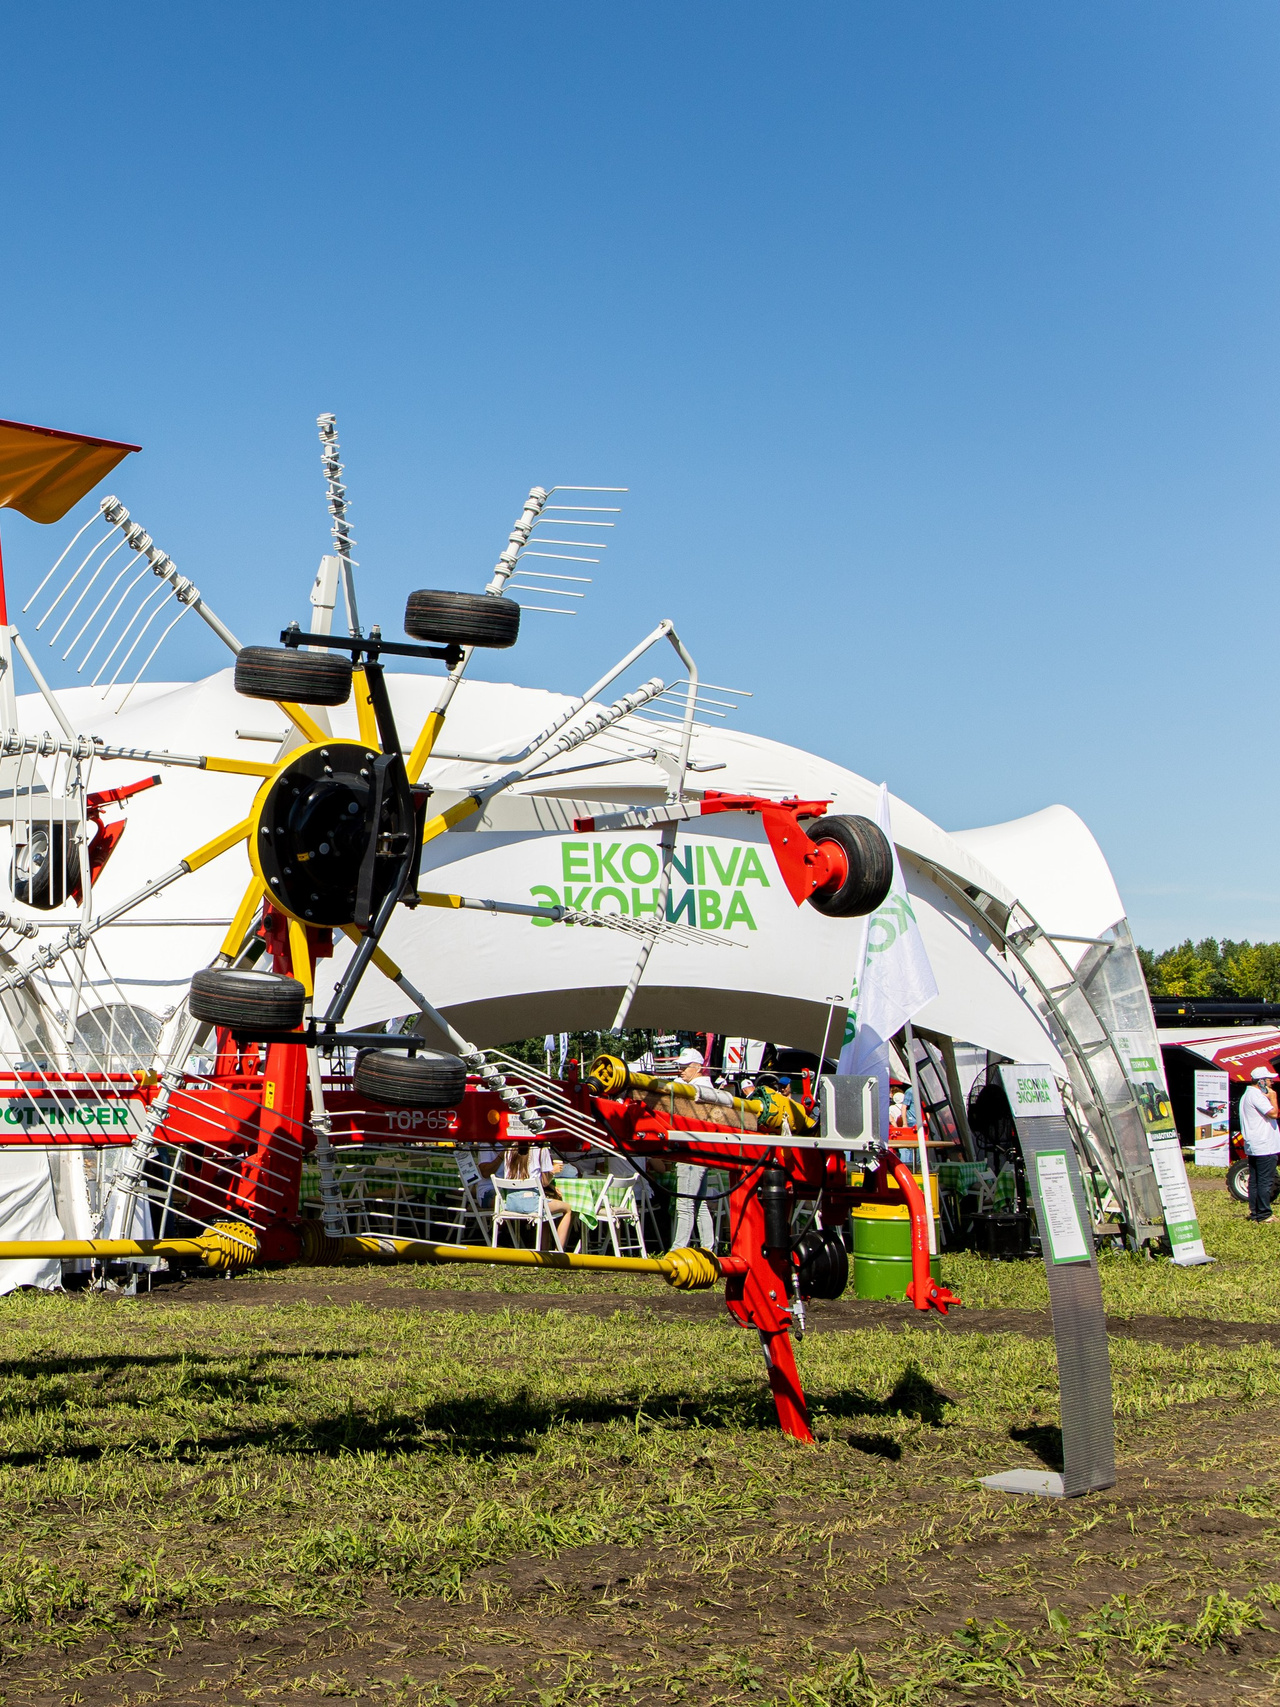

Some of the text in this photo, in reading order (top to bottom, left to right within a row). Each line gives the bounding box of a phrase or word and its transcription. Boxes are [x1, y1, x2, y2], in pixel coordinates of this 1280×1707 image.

[561, 841, 771, 887] EKONIVA
[529, 885, 757, 930] ЭКОНИВА
[1017, 1078, 1050, 1091] EKONIVA
[1016, 1091, 1051, 1103] ЭКОНИВА
[385, 1110, 458, 1129] TOP 652
